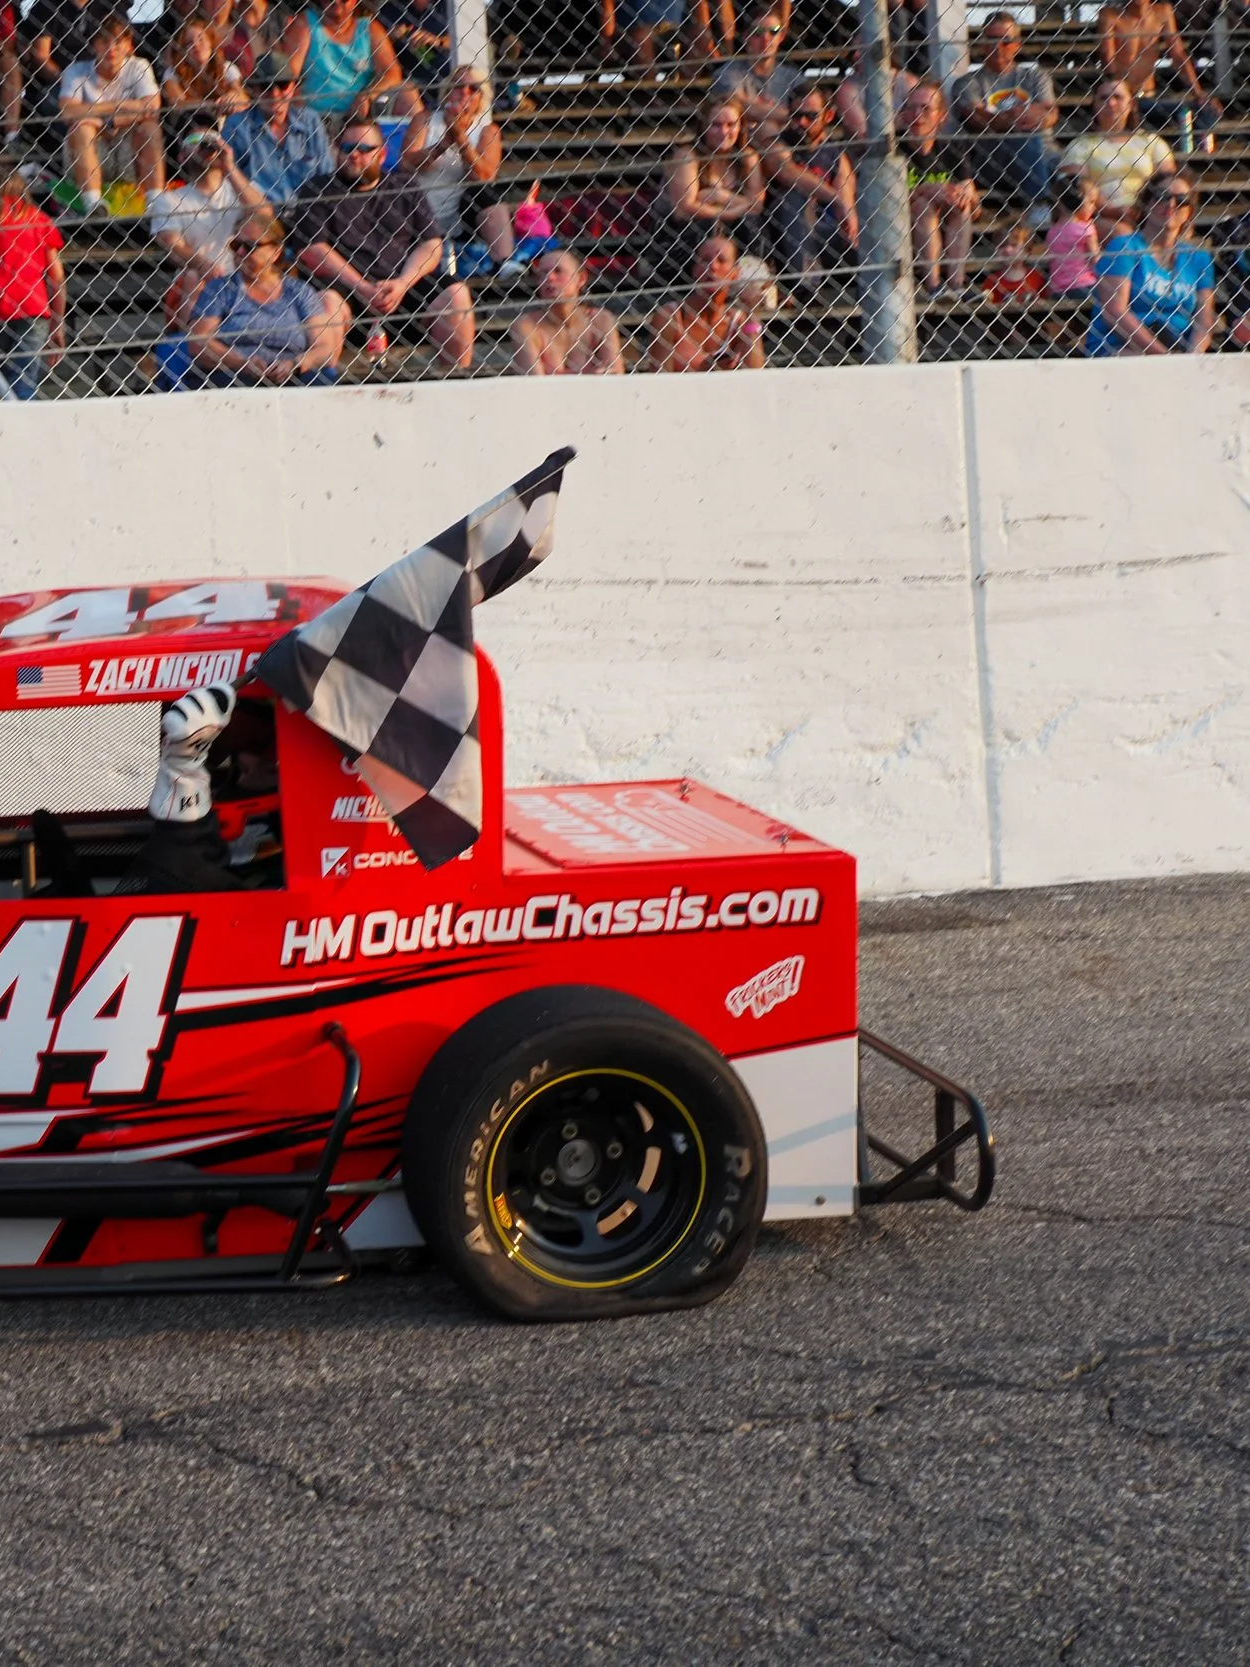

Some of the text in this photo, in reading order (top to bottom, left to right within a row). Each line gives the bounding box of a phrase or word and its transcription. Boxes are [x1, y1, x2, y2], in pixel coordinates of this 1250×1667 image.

[84, 657, 155, 696] ZACK
[353, 845, 475, 870] CONCE
[280, 886, 820, 966] HM OutlawChassis.com
[464, 1059, 549, 1255] AMERICAN
